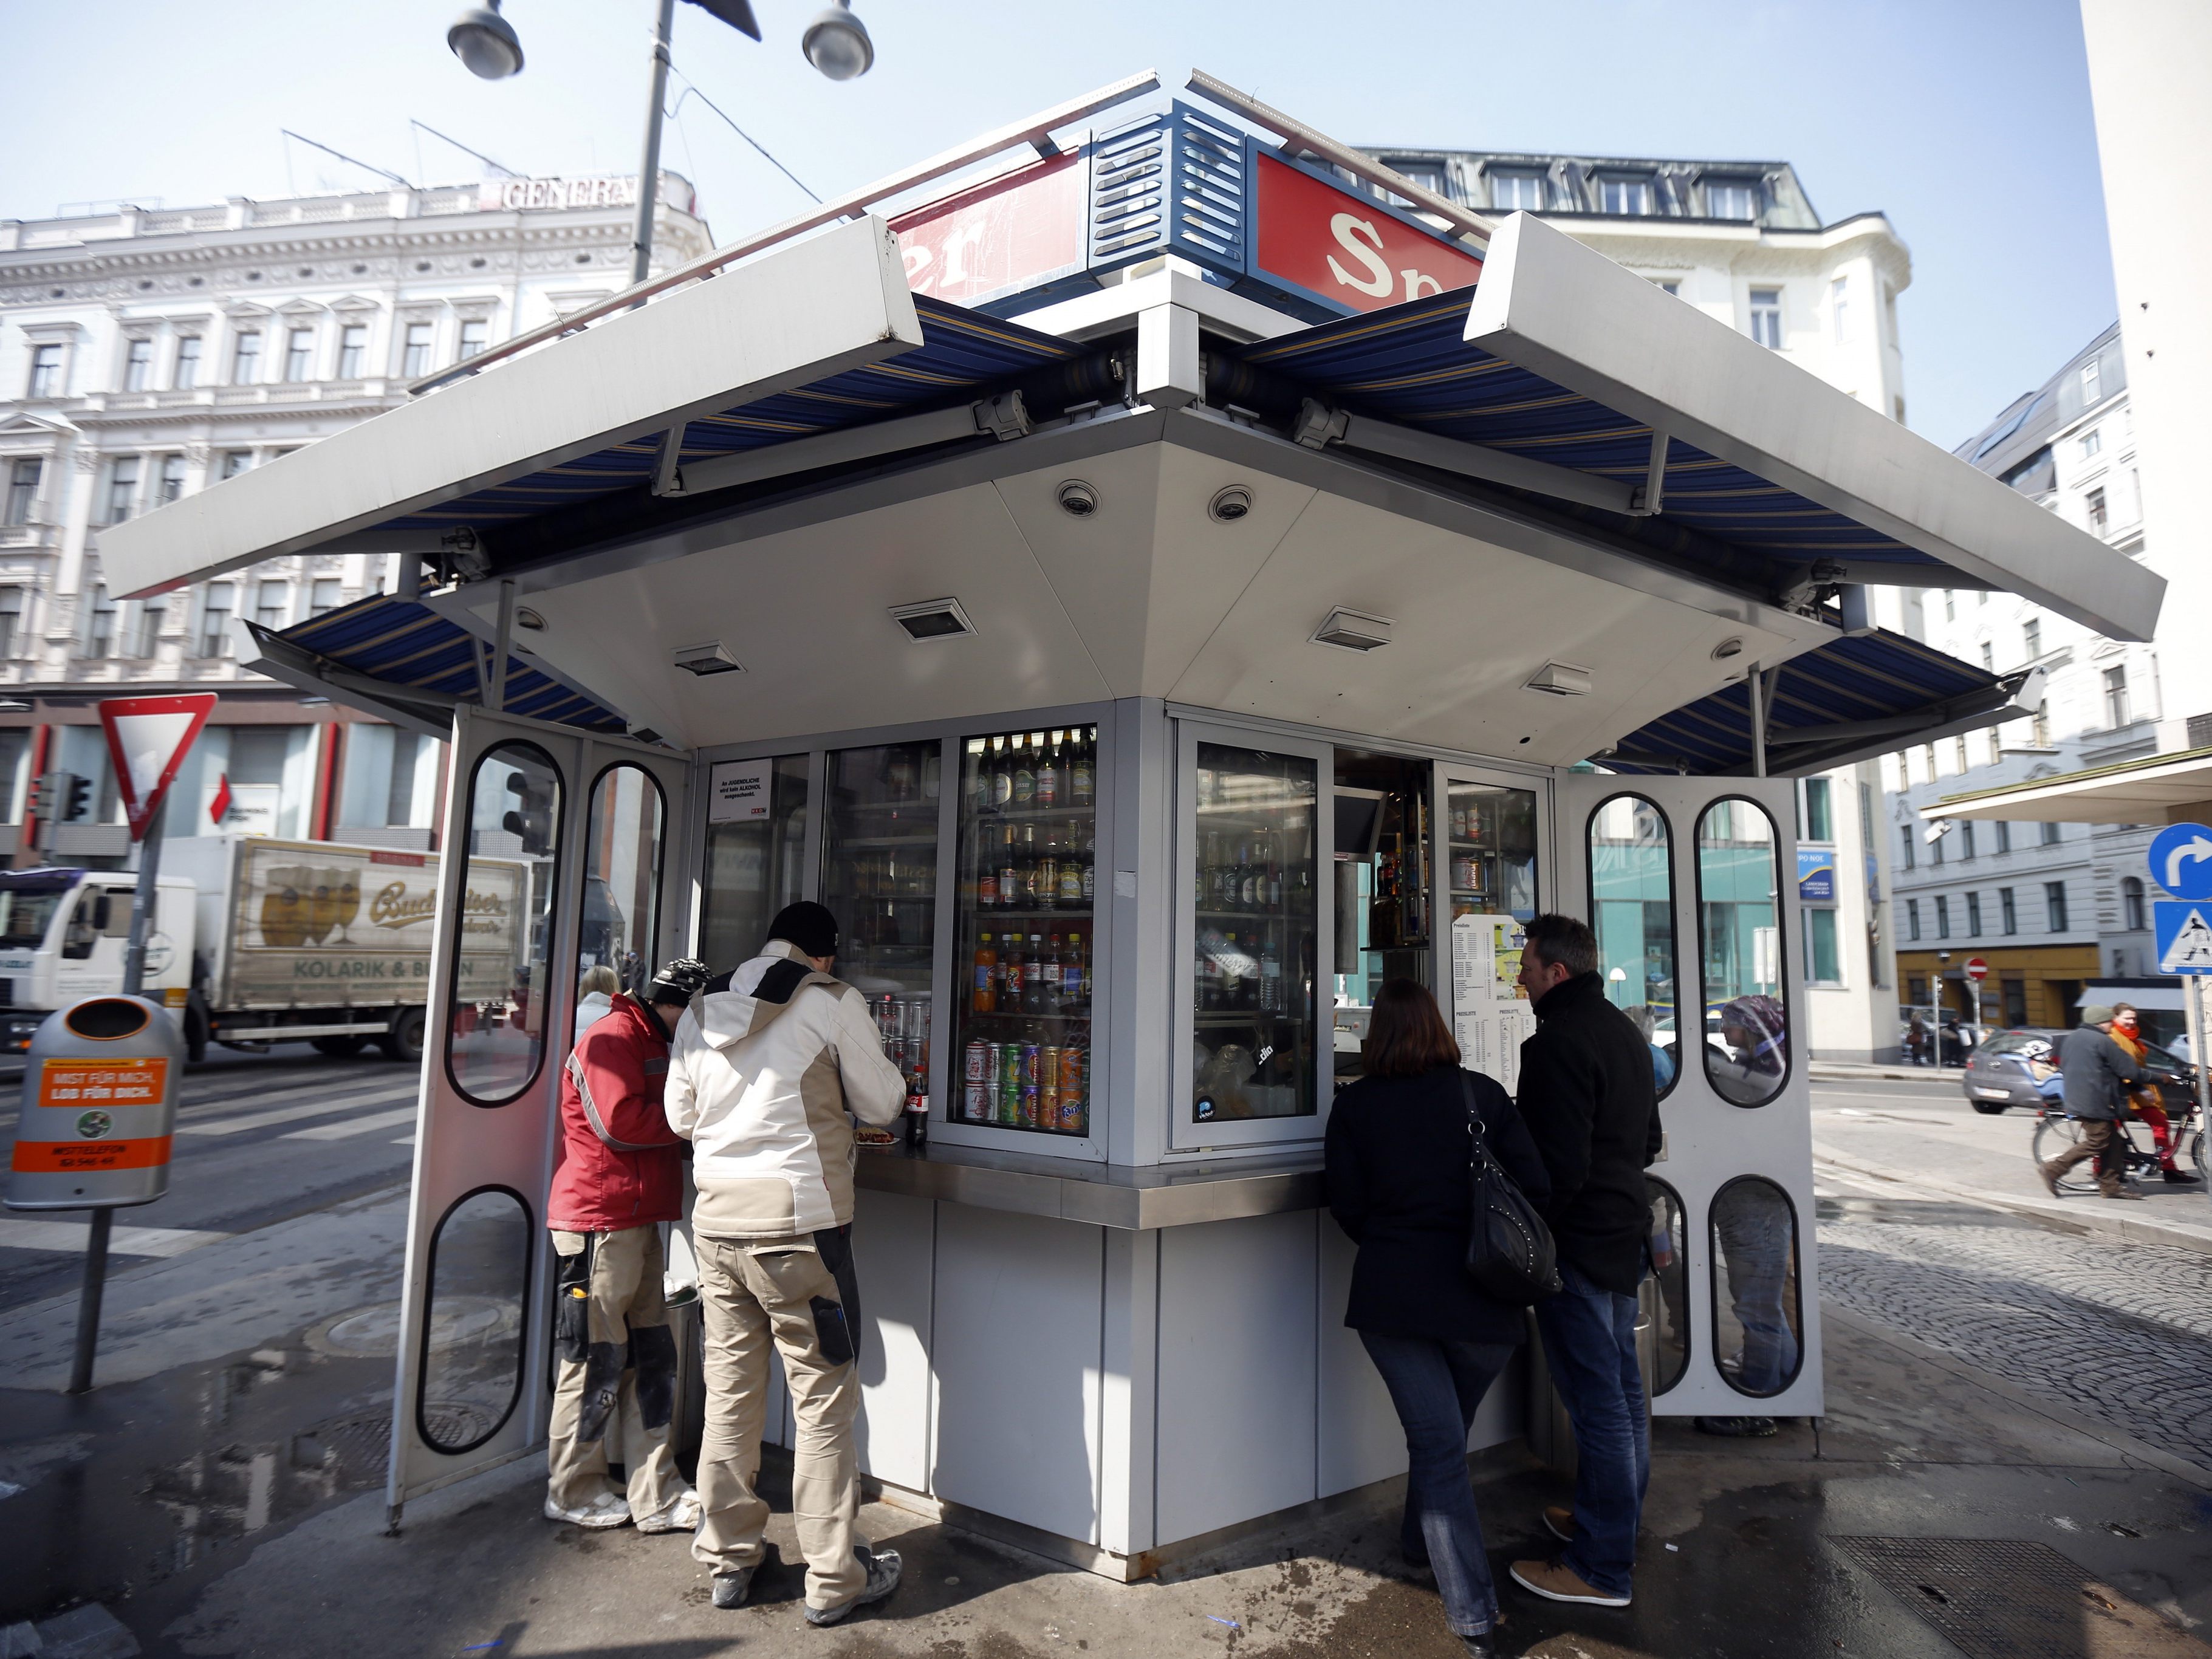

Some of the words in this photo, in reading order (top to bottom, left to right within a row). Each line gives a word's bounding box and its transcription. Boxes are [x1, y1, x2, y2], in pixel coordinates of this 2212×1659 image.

[503, 177, 640, 211] GENERA
[294, 962, 385, 977] KOLARIK
[392, 962, 406, 977] &
[52, 1073, 87, 1084] MIST
[88, 1071, 116, 1084] FÜR
